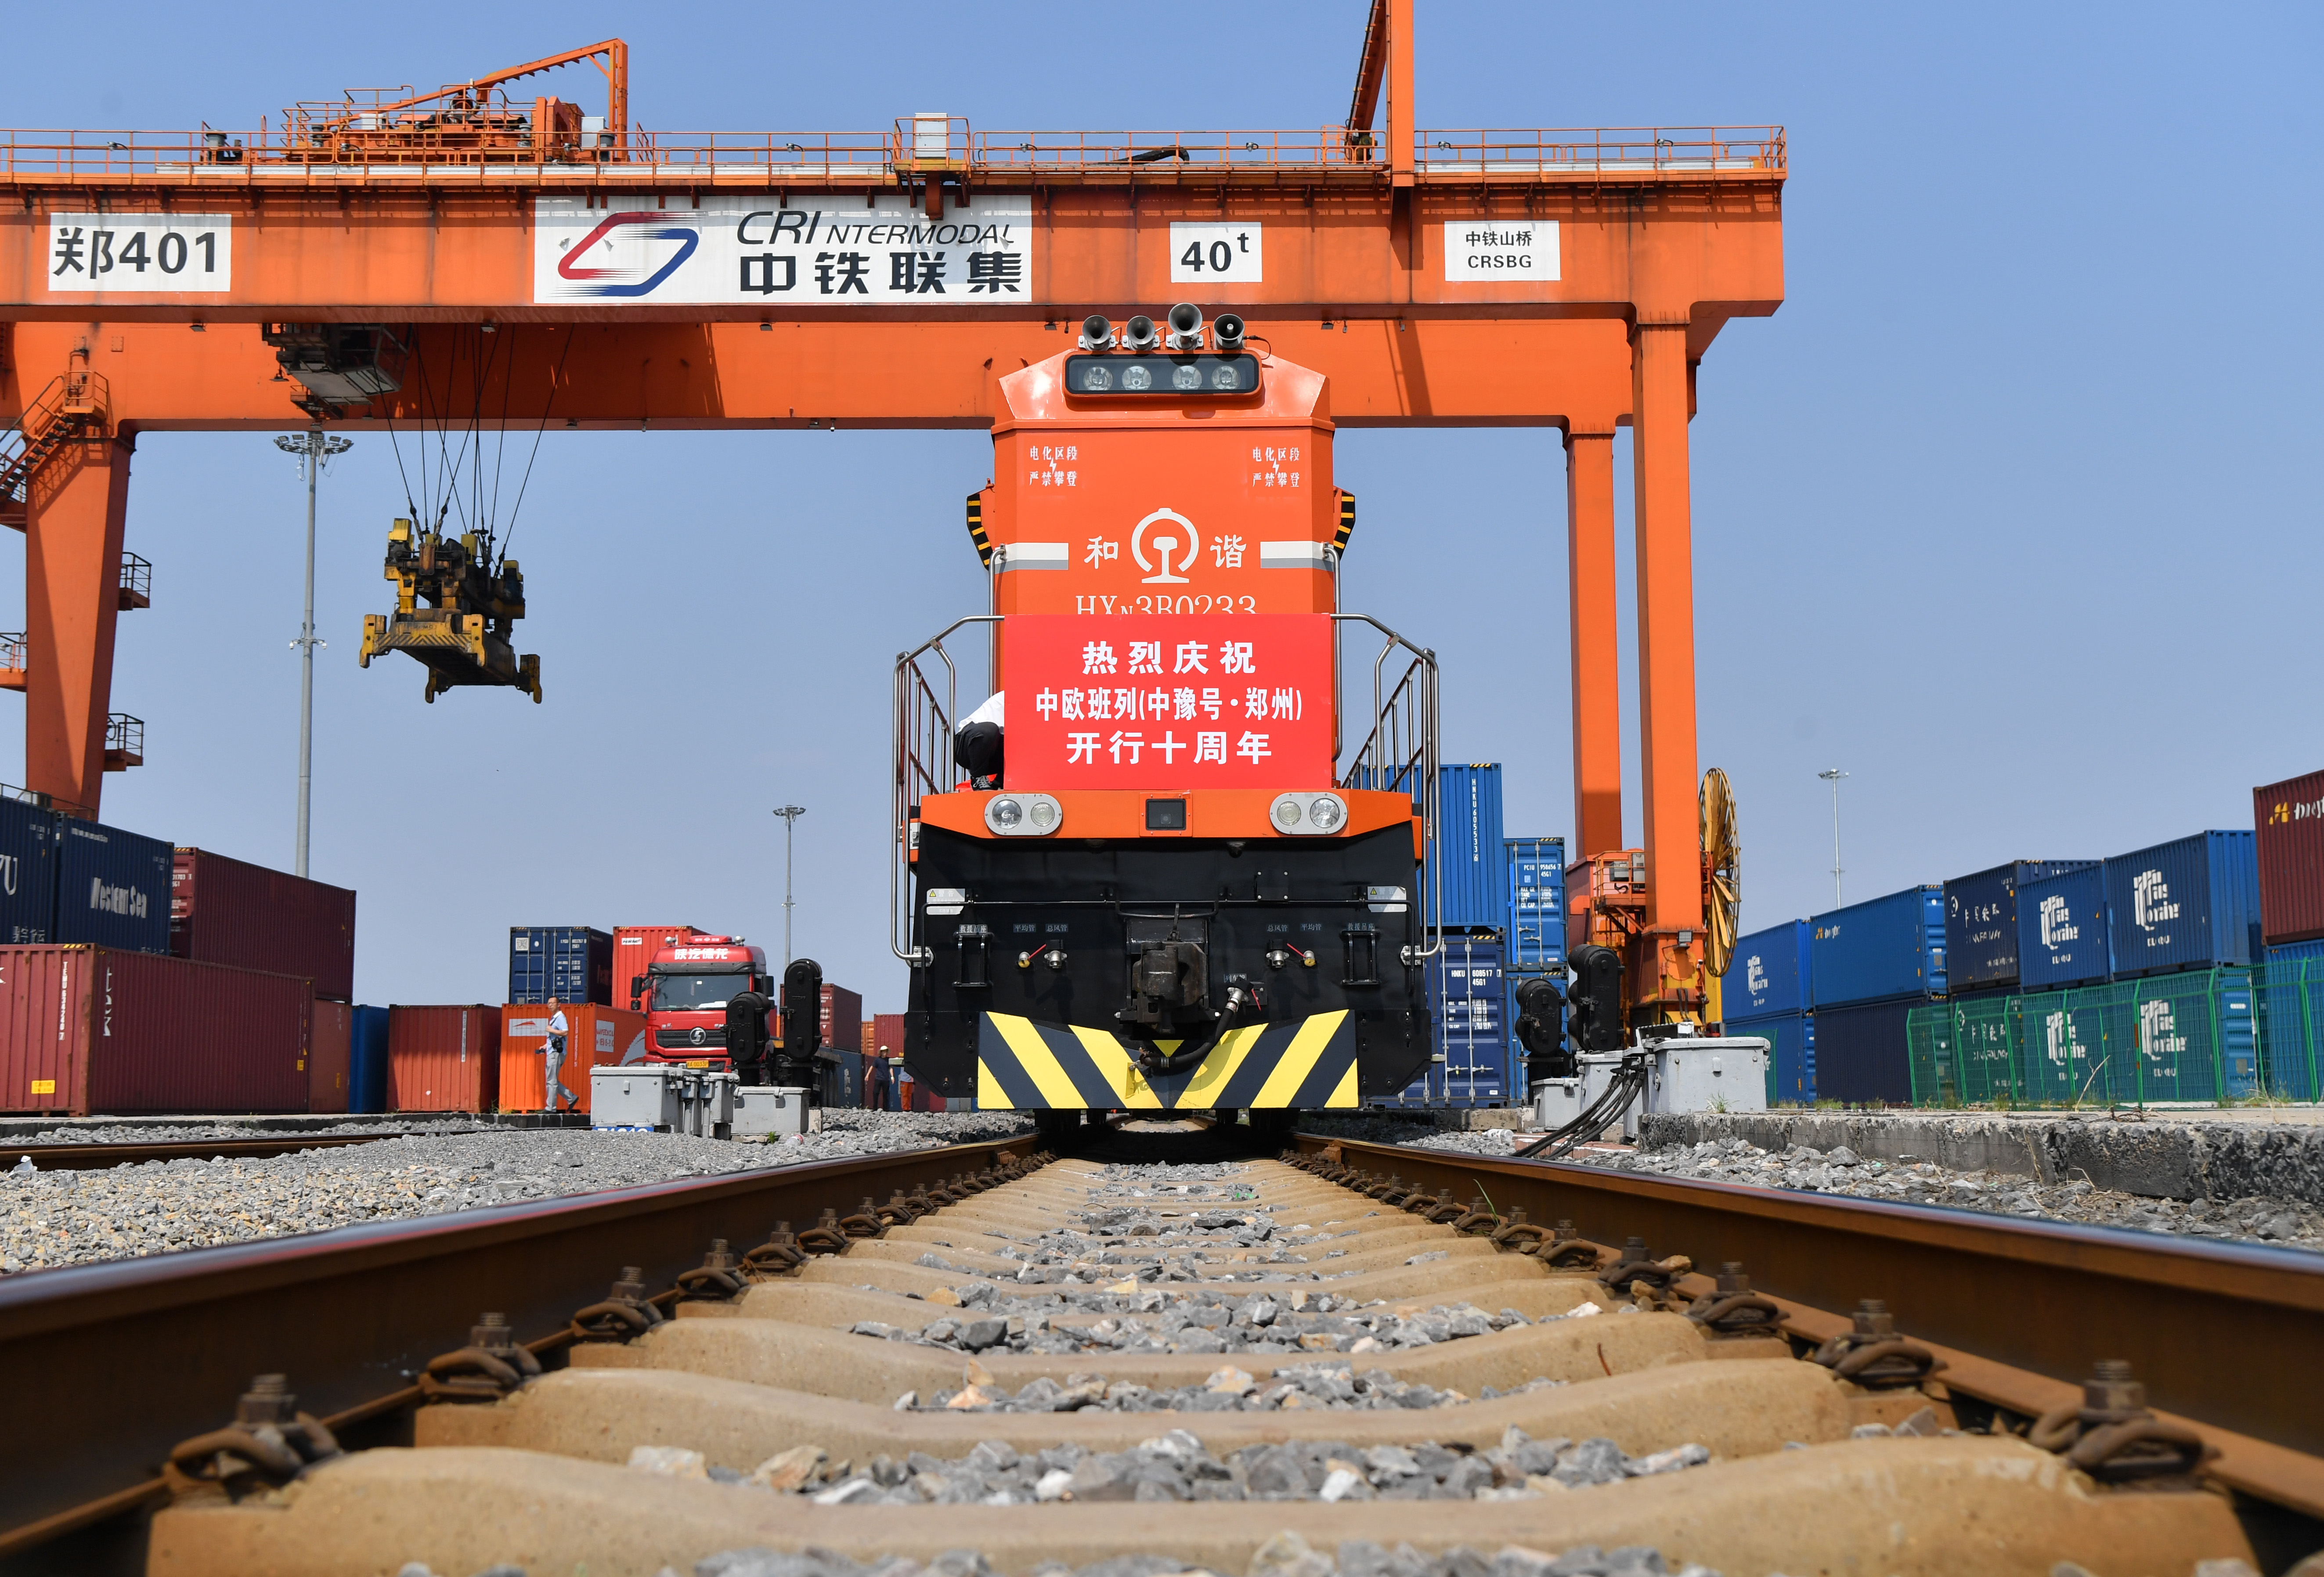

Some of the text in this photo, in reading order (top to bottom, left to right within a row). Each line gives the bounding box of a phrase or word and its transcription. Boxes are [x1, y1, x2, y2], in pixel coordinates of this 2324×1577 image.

[1466, 231, 1533, 247] 中铁山桥
[54, 227, 215, 279] 郑401
[1467, 255, 1532, 268] CRSBG
[740, 252, 1021, 295] 中铁联集
[1030, 446, 1077, 461] 电化区段
[1253, 447, 1299, 461] 电化区段
[1029, 471, 1077, 486] 严禁攀登
[1252, 472, 1299, 487] 严禁攀登
[1084, 535, 1247, 569] 和 谐
[1082, 641, 1256, 674] 热烈庆祝
[1066, 731, 1272, 764] 开行十周年
[1348, 922, 1375, 931] 救援吊座
